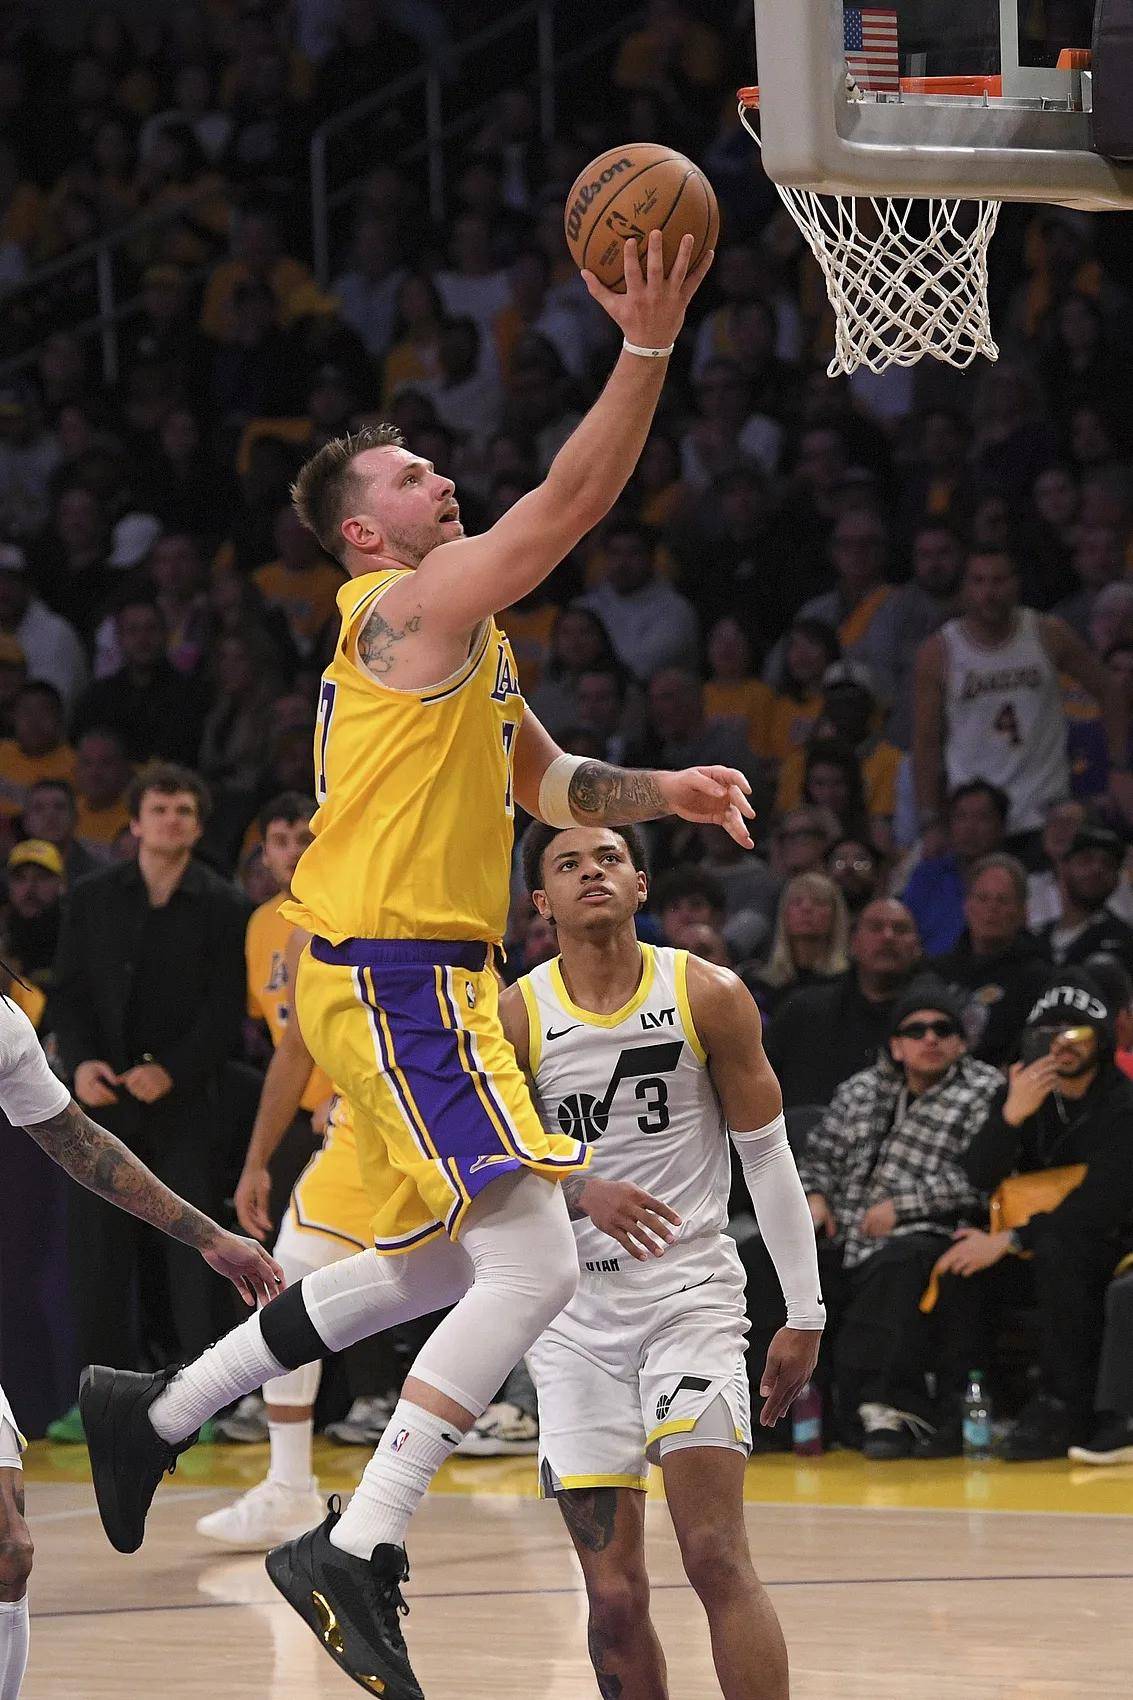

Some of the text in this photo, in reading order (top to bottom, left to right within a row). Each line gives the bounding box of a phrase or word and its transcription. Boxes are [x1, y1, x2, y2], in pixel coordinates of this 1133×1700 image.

[566, 157, 635, 242] Wilson
[640, 1007, 676, 1030] LVT
[634, 1077, 670, 1134] 3
